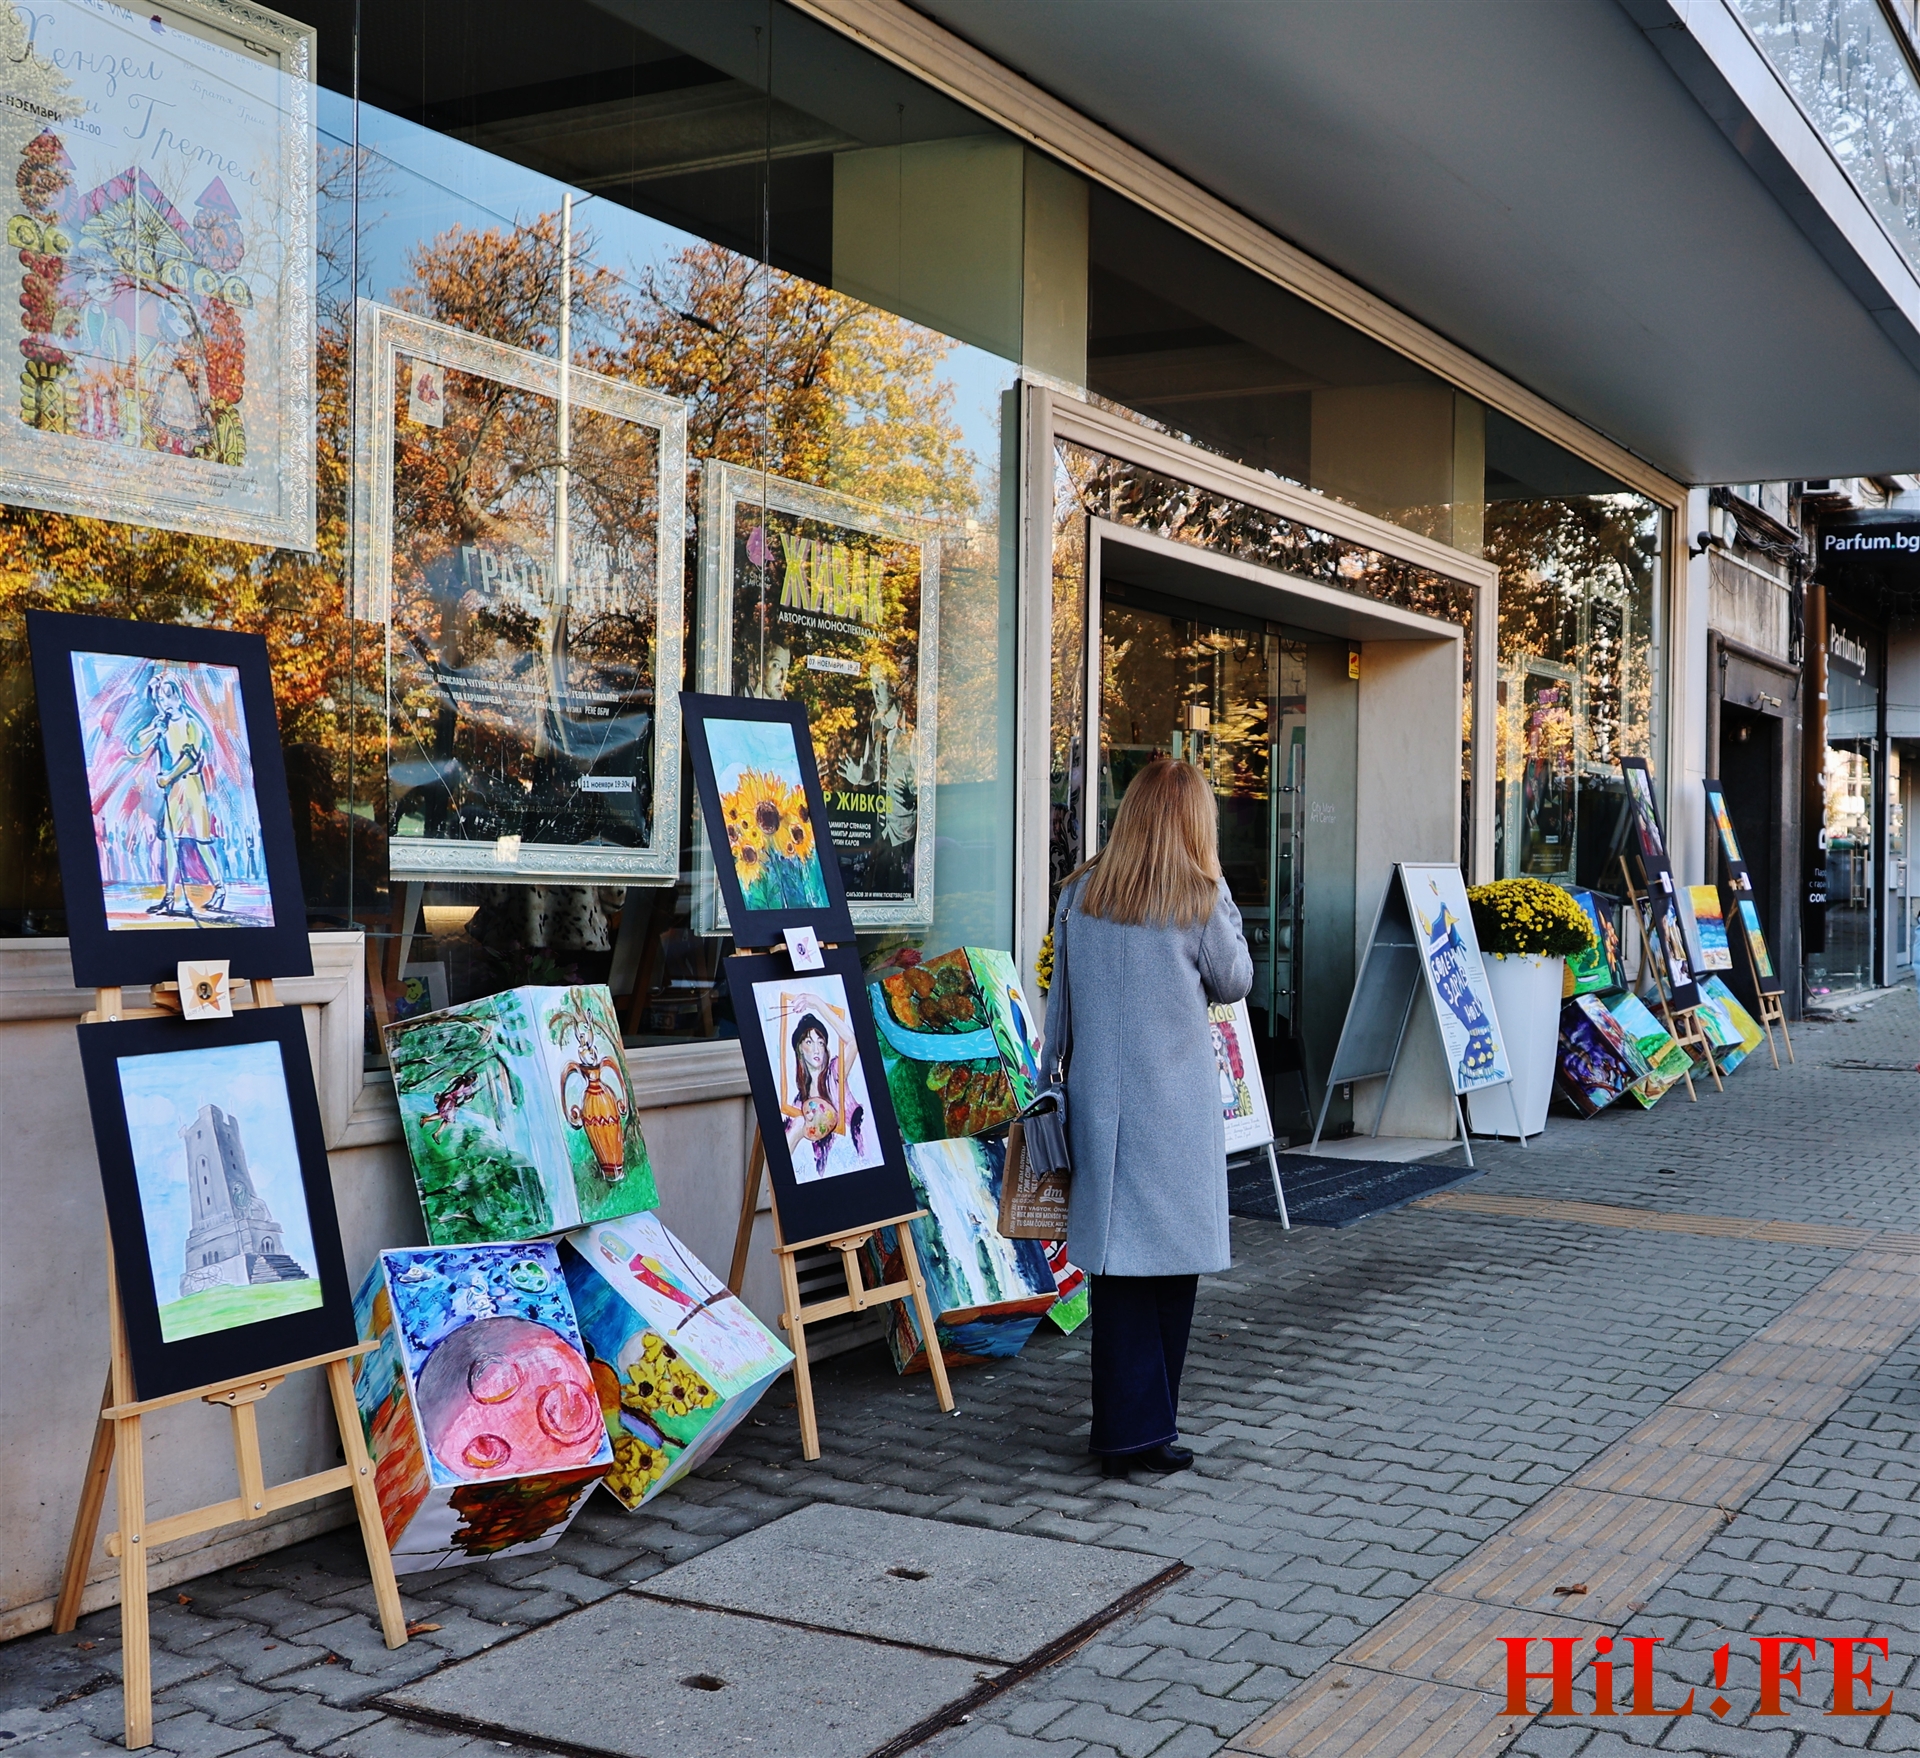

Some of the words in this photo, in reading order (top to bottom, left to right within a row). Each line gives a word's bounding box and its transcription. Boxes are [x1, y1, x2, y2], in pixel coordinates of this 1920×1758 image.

[73, 118, 101, 136] 11:00
[1825, 532, 1920, 554] Parfum.bg
[780, 533, 886, 626] ЖИВАК
[779, 611, 817, 628] АВТОРСКИ
[817, 619, 877, 640] МОНОСПЕКТАКЪЛ
[1830, 623, 1867, 677] Parfum.bg
[583, 780, 590, 788] 11
[836, 792, 893, 814] ЖИВКОВ
[848, 831, 871, 839] ДИМИТРОВ
[1043, 1186, 1063, 1197] dm
